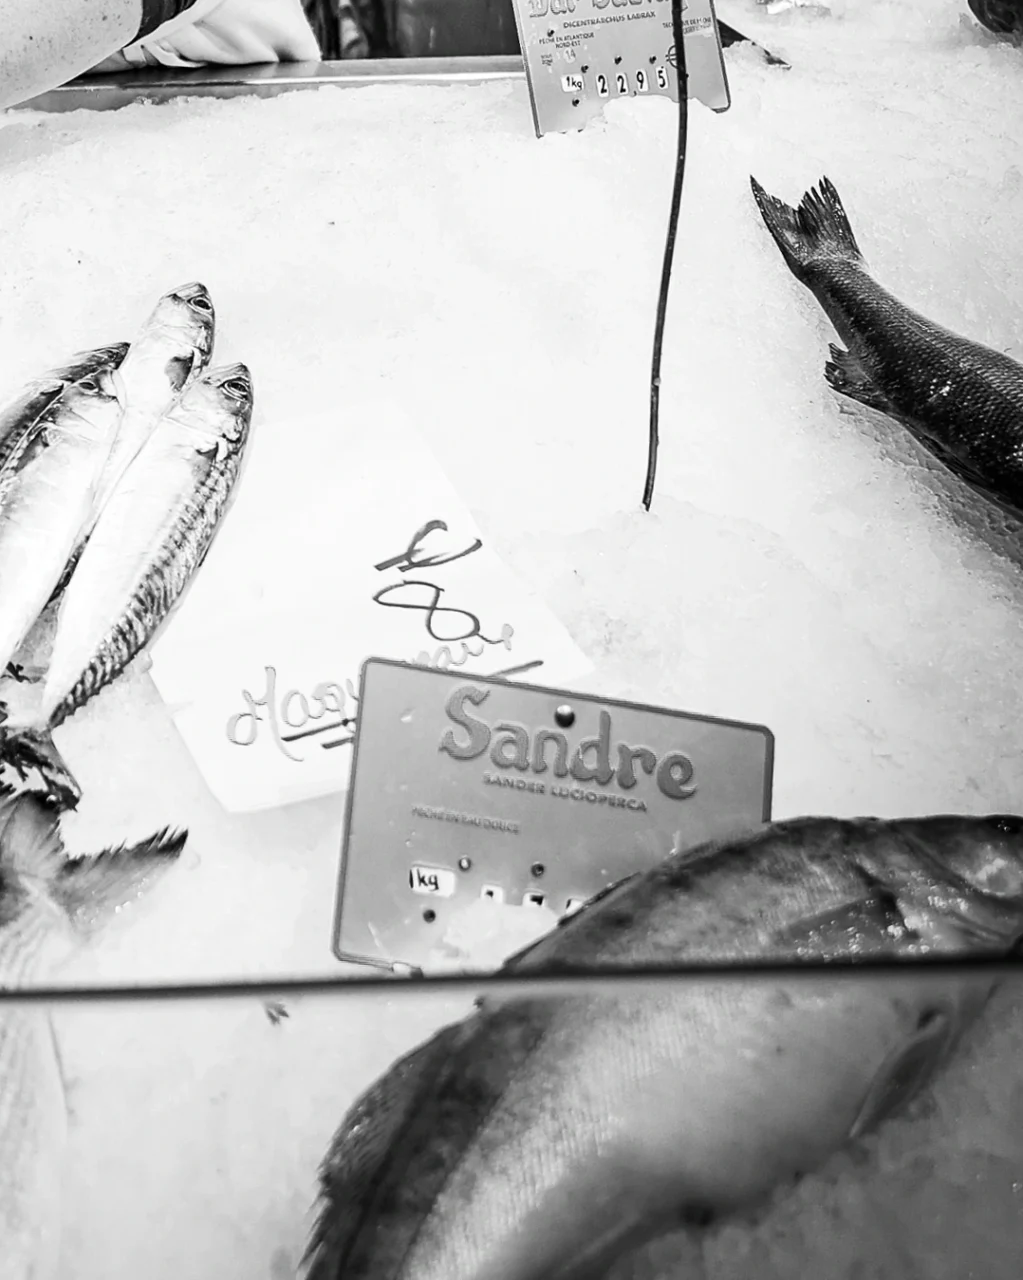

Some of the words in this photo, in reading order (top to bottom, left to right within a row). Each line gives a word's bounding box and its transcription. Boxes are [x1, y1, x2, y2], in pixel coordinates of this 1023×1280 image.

[565, 75, 584, 91] 1kg
[438, 684, 699, 801] Sandre
[482, 773, 546, 795] SANDER
[550, 784, 648, 813] LUCIOPERCA
